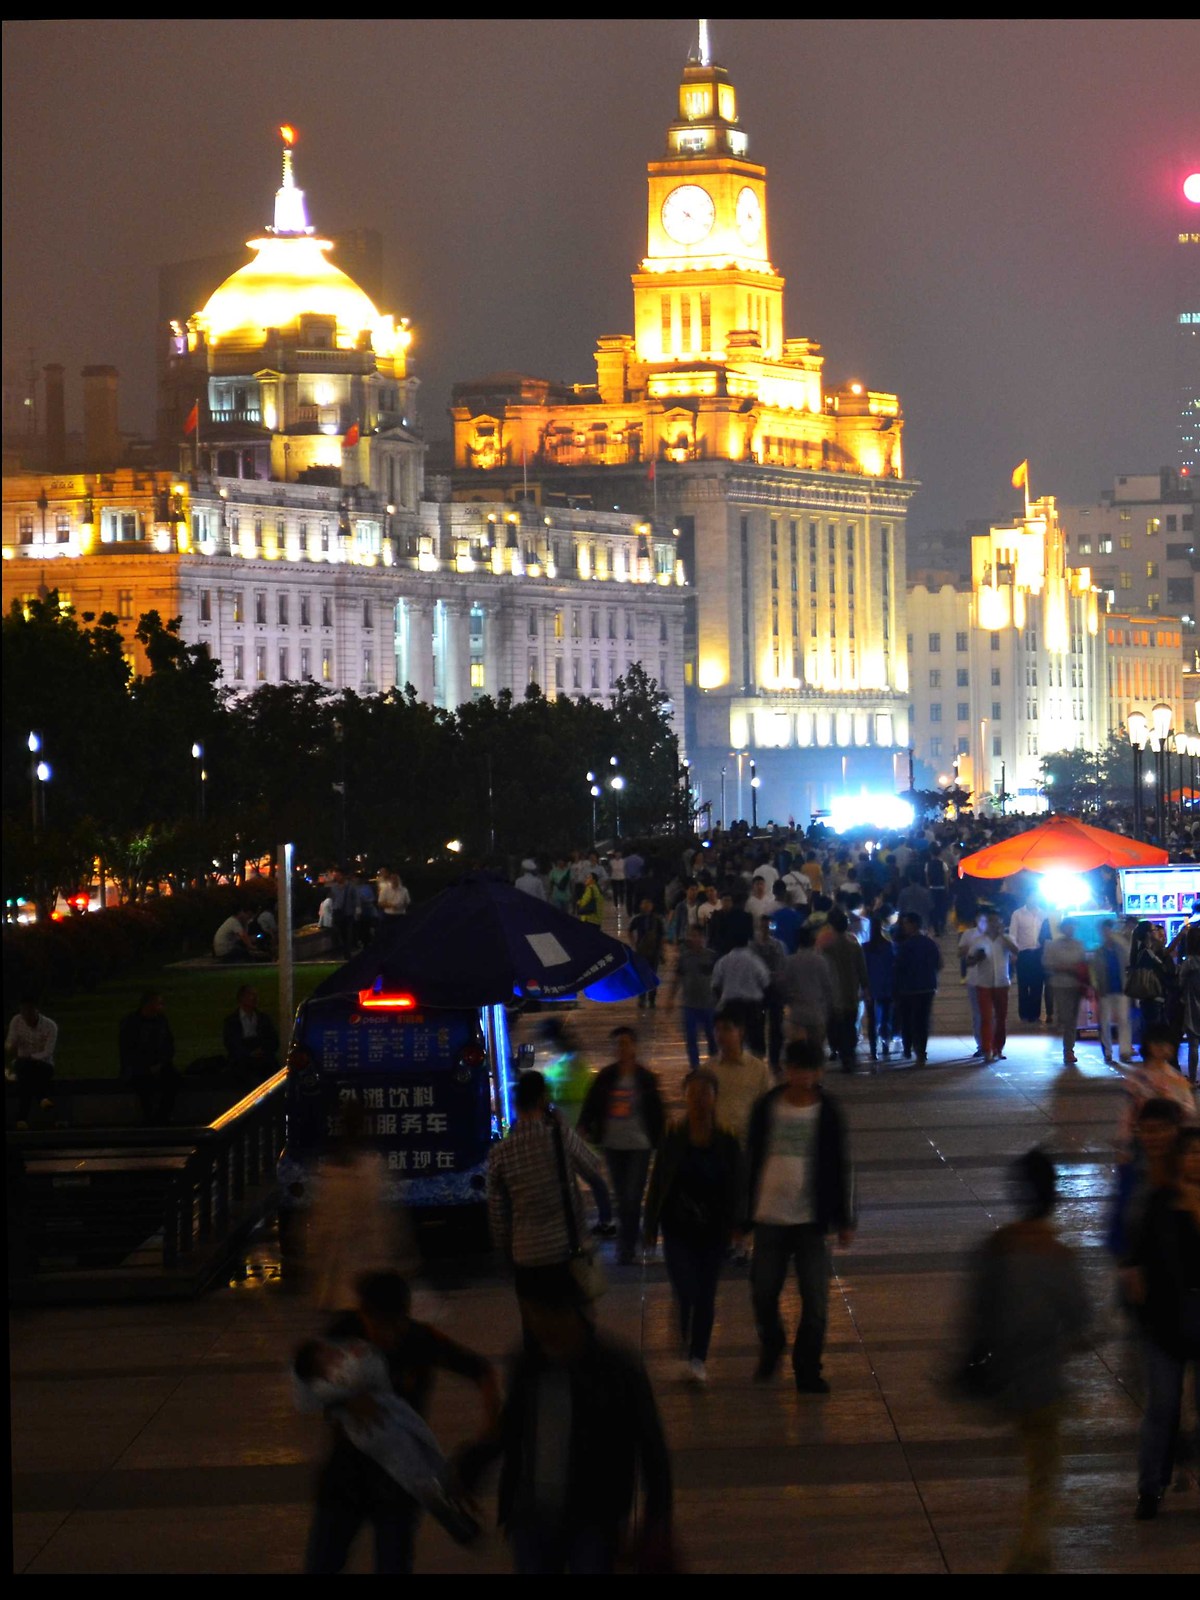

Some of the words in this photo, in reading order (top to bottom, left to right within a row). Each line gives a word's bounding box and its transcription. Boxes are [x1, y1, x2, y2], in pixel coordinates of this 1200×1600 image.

[362, 1015, 389, 1024] pepsi
[338, 1086, 435, 1108] 外滩饮料
[388, 1150, 455, 1169] 就现在
